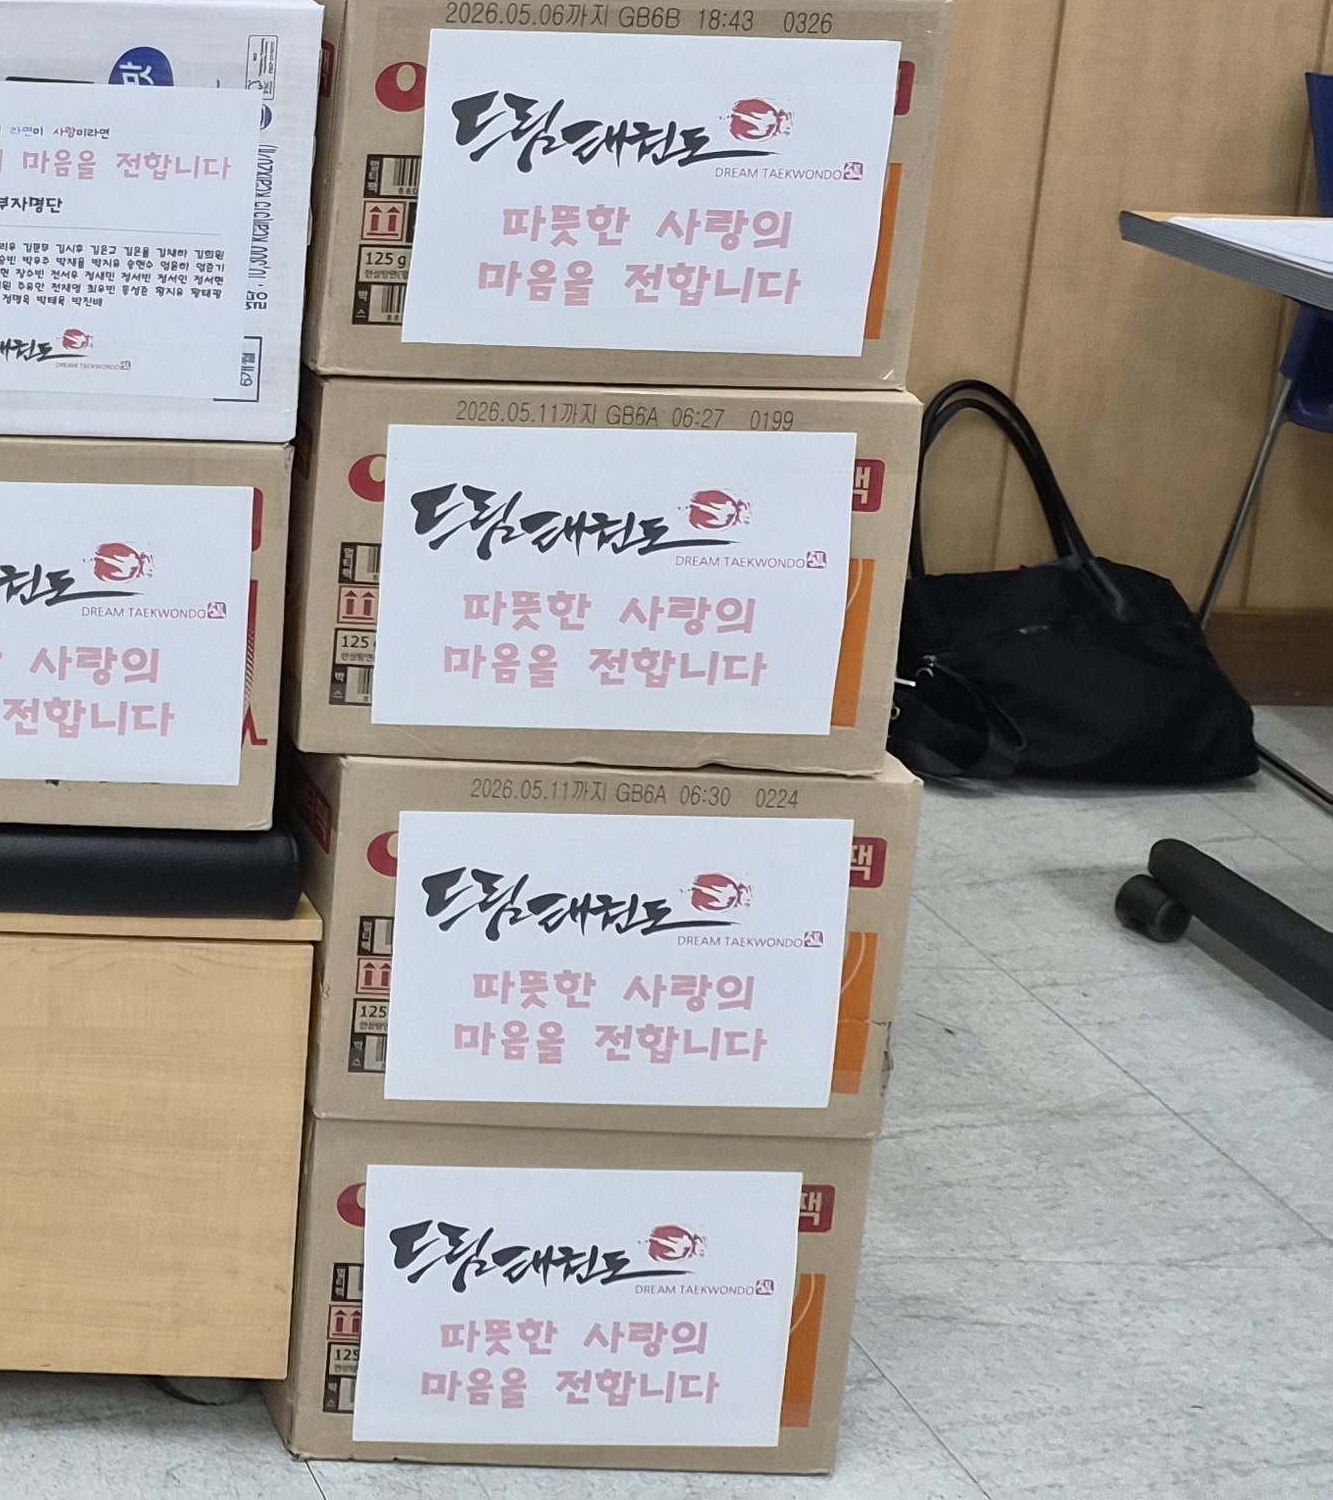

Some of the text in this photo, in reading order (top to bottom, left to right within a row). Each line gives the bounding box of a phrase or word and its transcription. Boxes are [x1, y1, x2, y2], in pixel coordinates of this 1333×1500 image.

[446, 2, 833, 35] 2026.05.06까지 GB6B 18:43 0326
[23, 149, 96, 180] 마음을
[116, 152, 231, 180] 전합니다
[715, 166, 843, 182] DREAM TAEKWONDO
[503, 204, 792, 251] 따뜻한 사랑의
[365, 252, 393, 265] 125
[478, 259, 801, 306] 마음을 전합니다
[456, 401, 794, 431] 2026.05.11까지 GB6A 06:27 0199
[675, 555, 805, 569] DREAM TAEKWONDO
[82, 606, 206, 619] DREAM TAEKWONDO
[464, 590, 755, 635] 따뜻한 사랑의
[341, 636, 369, 648] 125
[29, 646, 159, 685] 사랑의
[444, 643, 767, 688] 마음을 전합니다
[3, 696, 174, 738] 전합니다
[471, 778, 799, 809] 2026.05.11까지 GB6A 06:30 0224
[473, 969, 754, 1012] 따뜻한 사랑의
[454, 1020, 767, 1064] 마음을 전합니다
[440, 1318, 708, 1357] 따뜻한 사랑의
[421, 1367, 720, 1409] 마음을 전합니다
